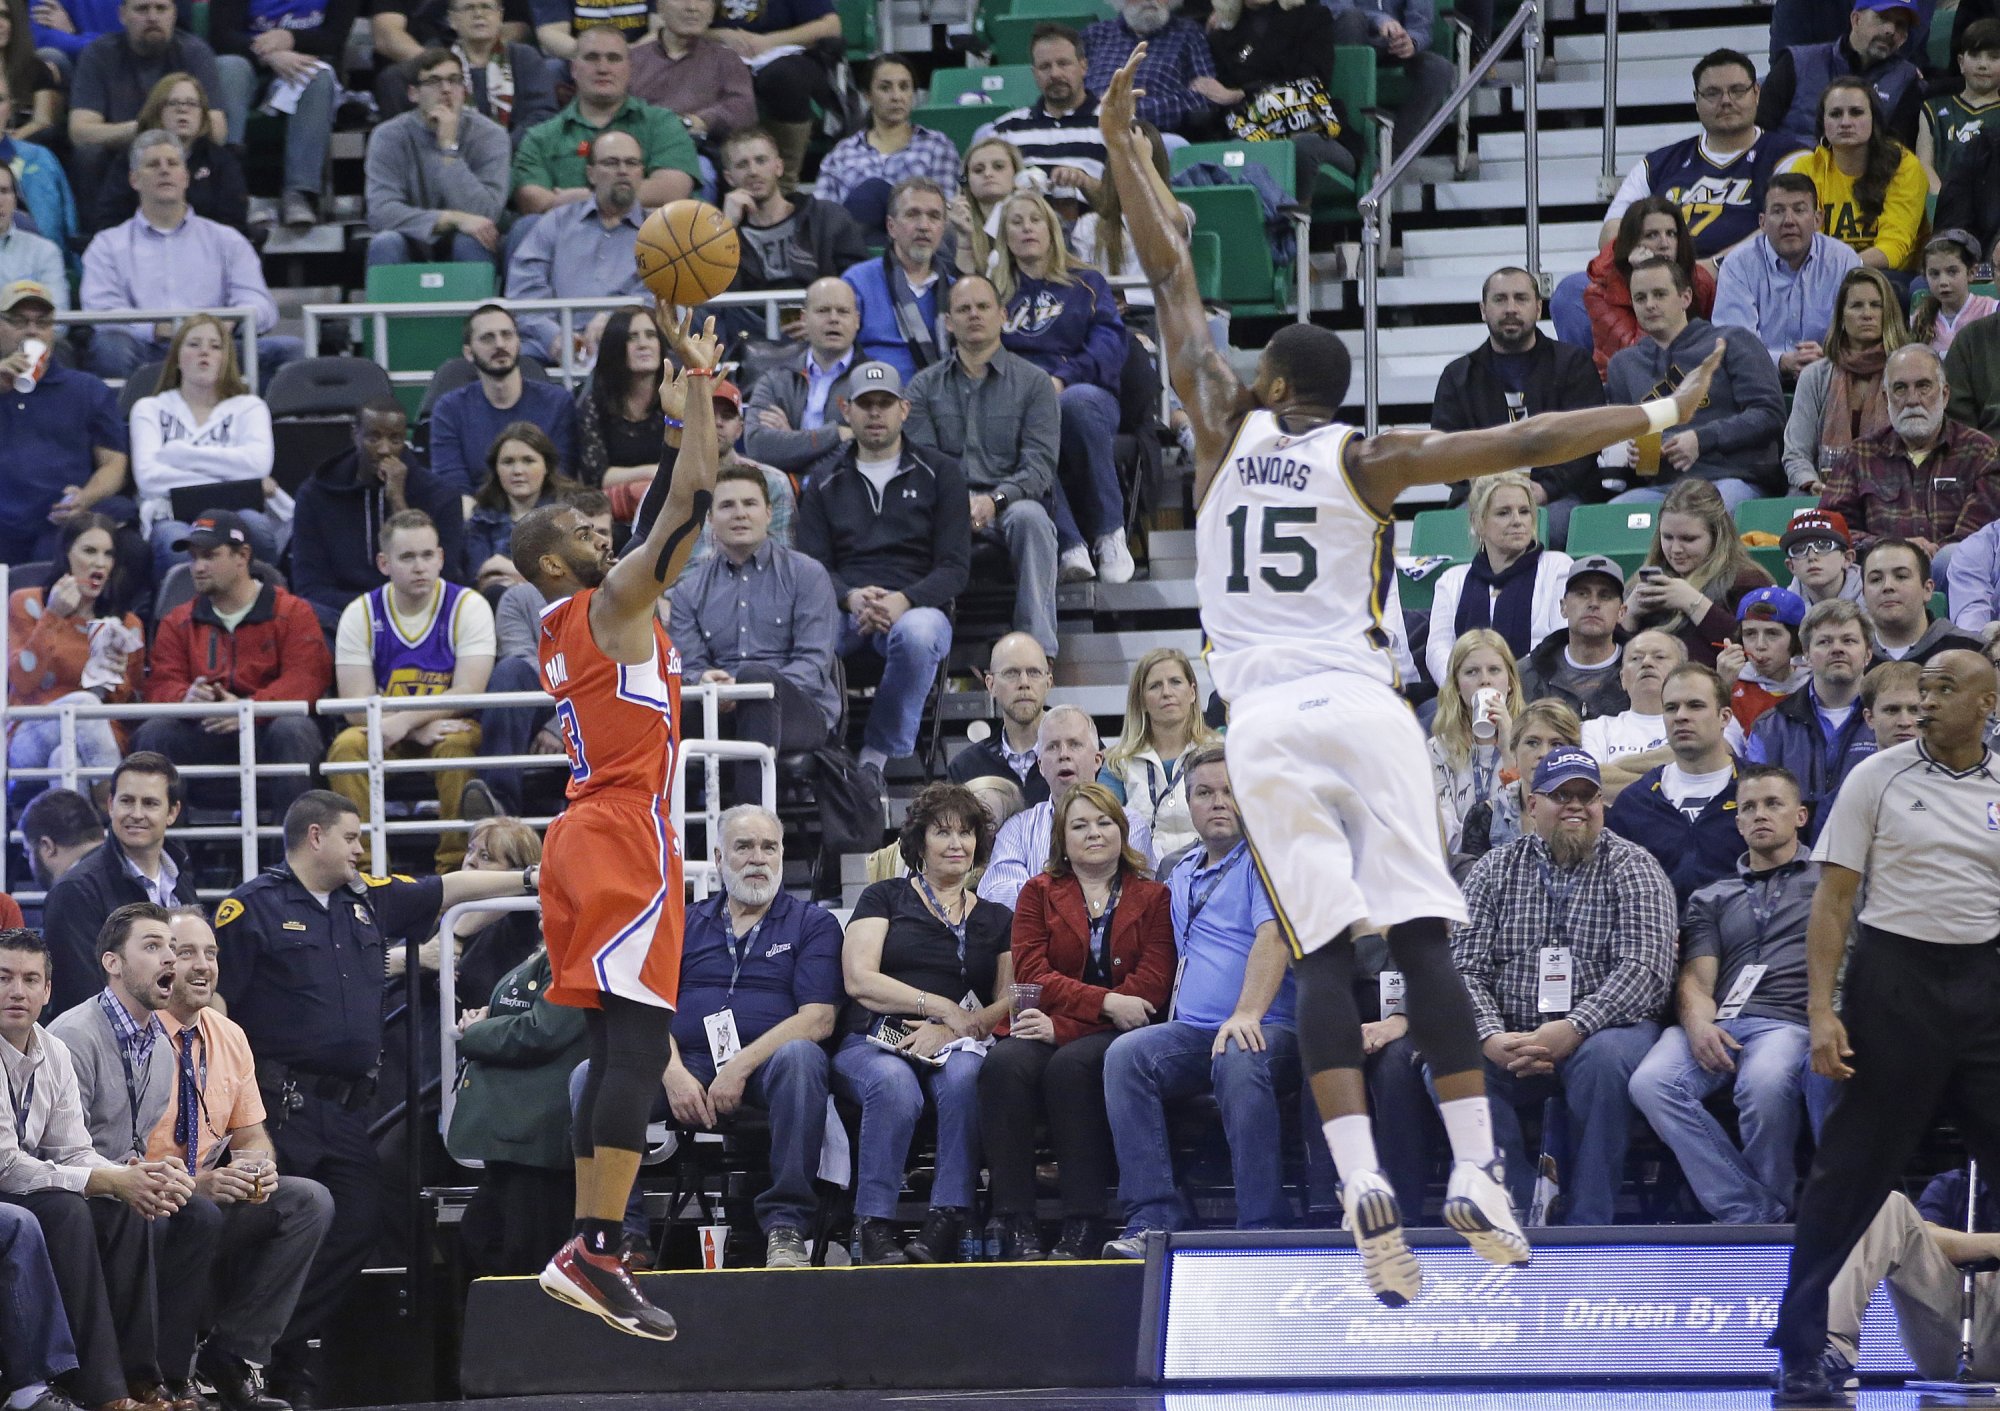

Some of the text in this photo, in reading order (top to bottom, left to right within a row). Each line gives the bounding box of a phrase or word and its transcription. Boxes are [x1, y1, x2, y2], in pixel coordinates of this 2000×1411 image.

[1236, 456, 1311, 492] FAVORS
[1226, 505, 1317, 593] 15
[545, 652, 569, 690] PAUL
[556, 697, 592, 785] 3
[1547, 752, 1597, 768] JAZZ
[1563, 1297, 1676, 1330] Driven
[1685, 1297, 1734, 1334] By
